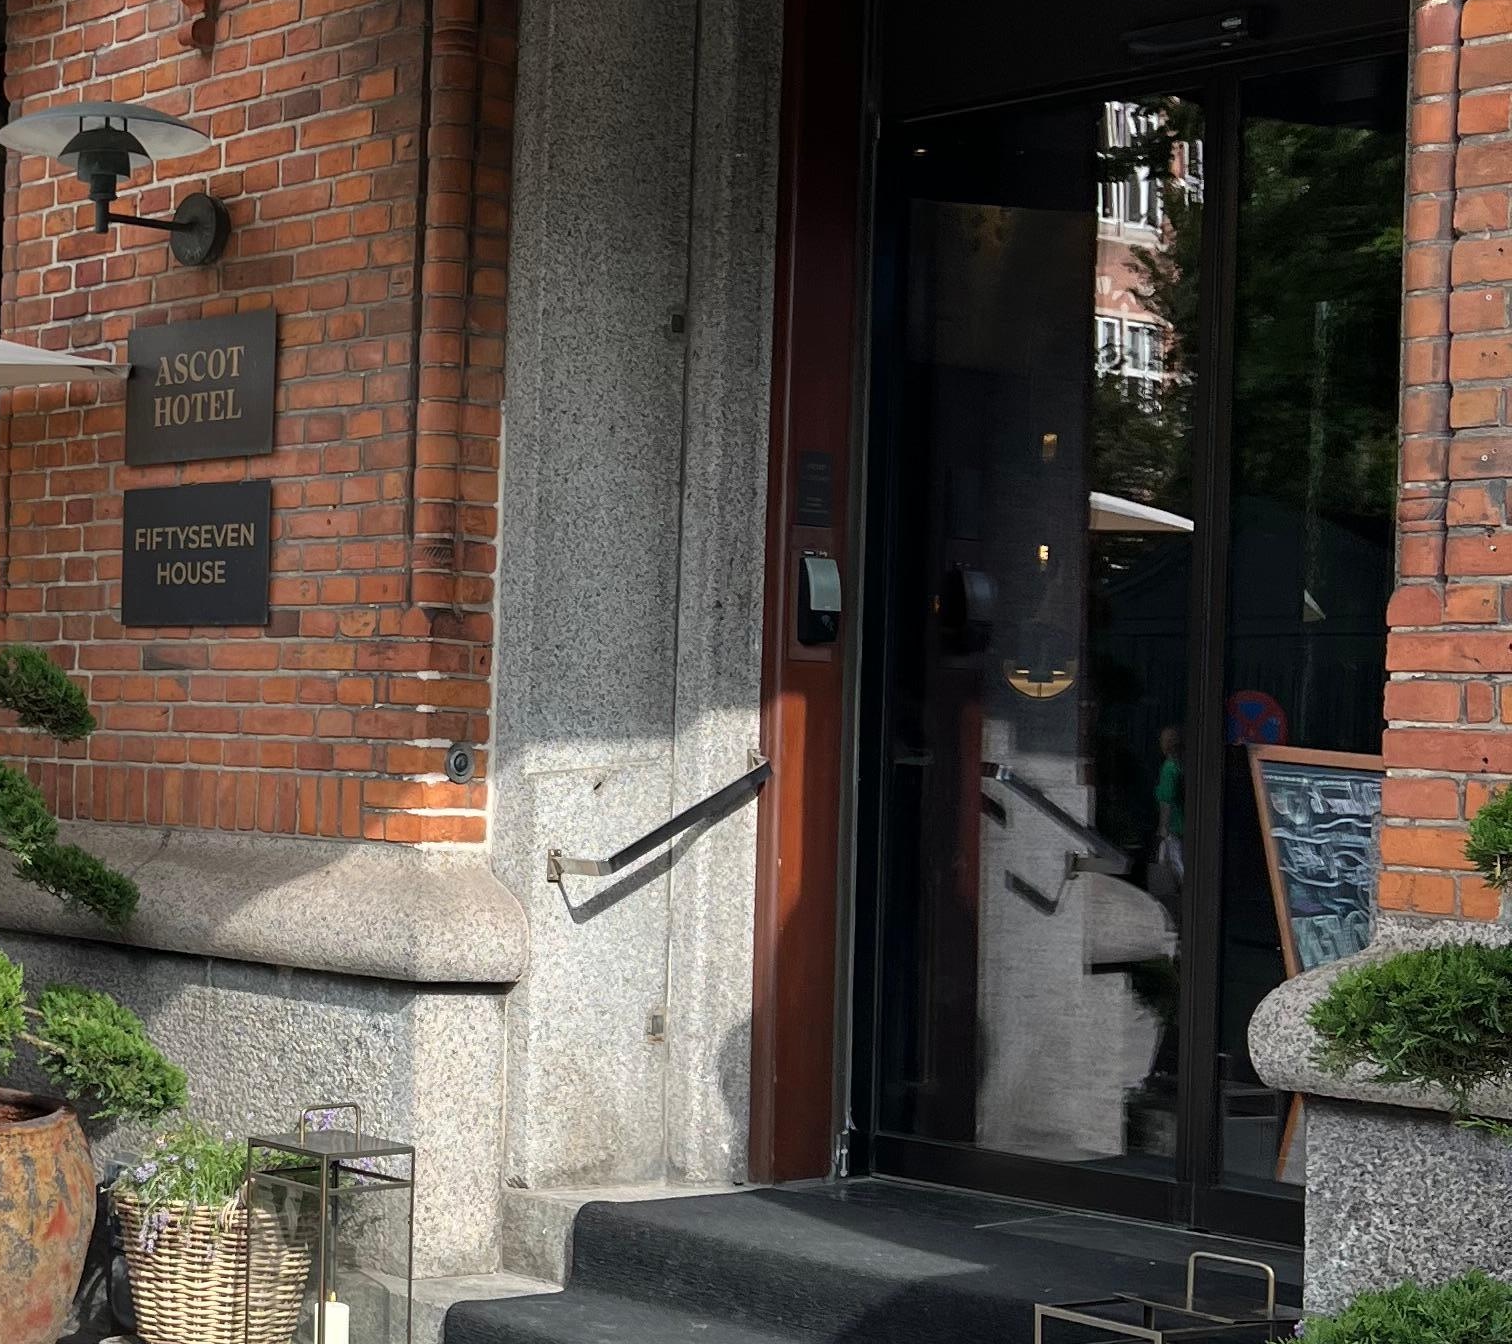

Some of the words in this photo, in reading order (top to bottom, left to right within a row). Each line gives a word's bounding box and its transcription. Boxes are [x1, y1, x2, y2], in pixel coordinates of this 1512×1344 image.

[155, 345, 245, 387] ASCOT
[154, 389, 242, 428] HOTEL
[135, 523, 256, 551] FIFTYSEVEN
[156, 561, 226, 586] HOUSE
